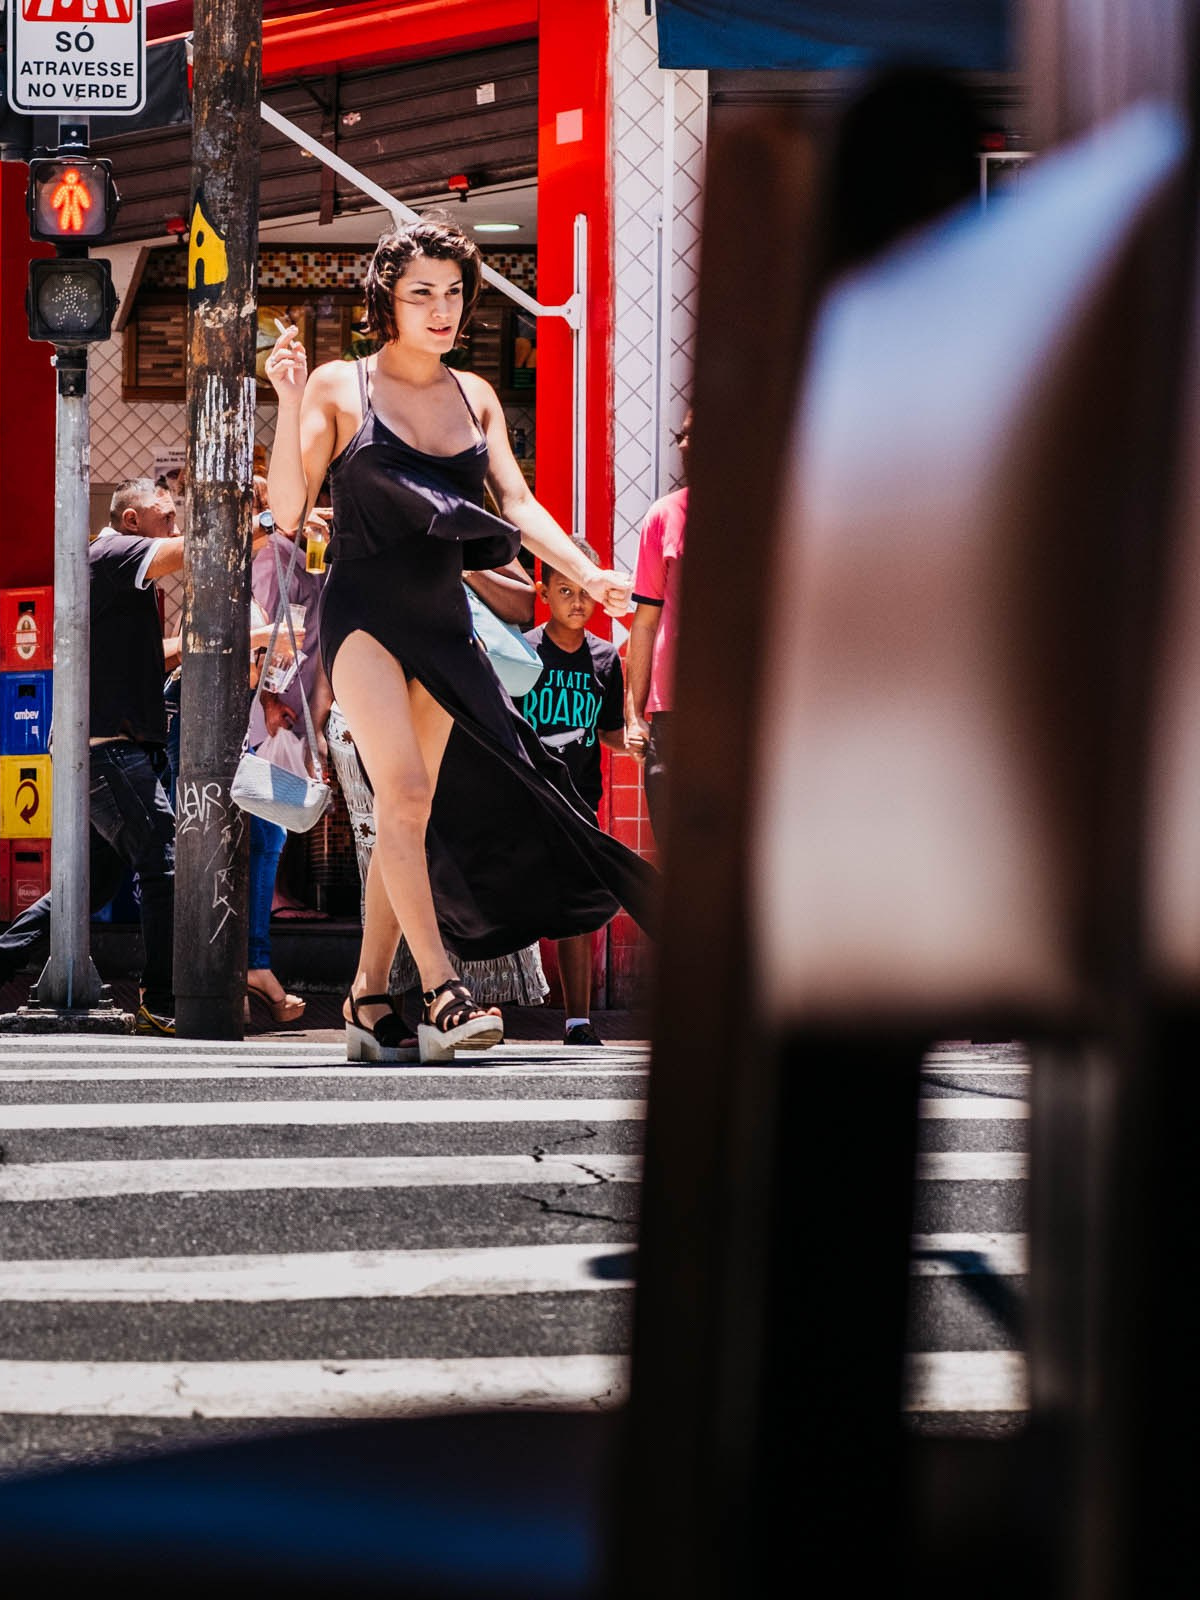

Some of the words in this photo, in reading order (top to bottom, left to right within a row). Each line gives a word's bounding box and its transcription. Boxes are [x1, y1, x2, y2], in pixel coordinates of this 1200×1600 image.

[55, 25, 95, 52] SÓ
[20, 61, 135, 77] ATRAVESSE
[28, 83, 55, 98] NO
[63, 83, 128, 99] VERDE
[544, 669, 591, 691] SKATE
[14, 708, 39, 720] ambev
